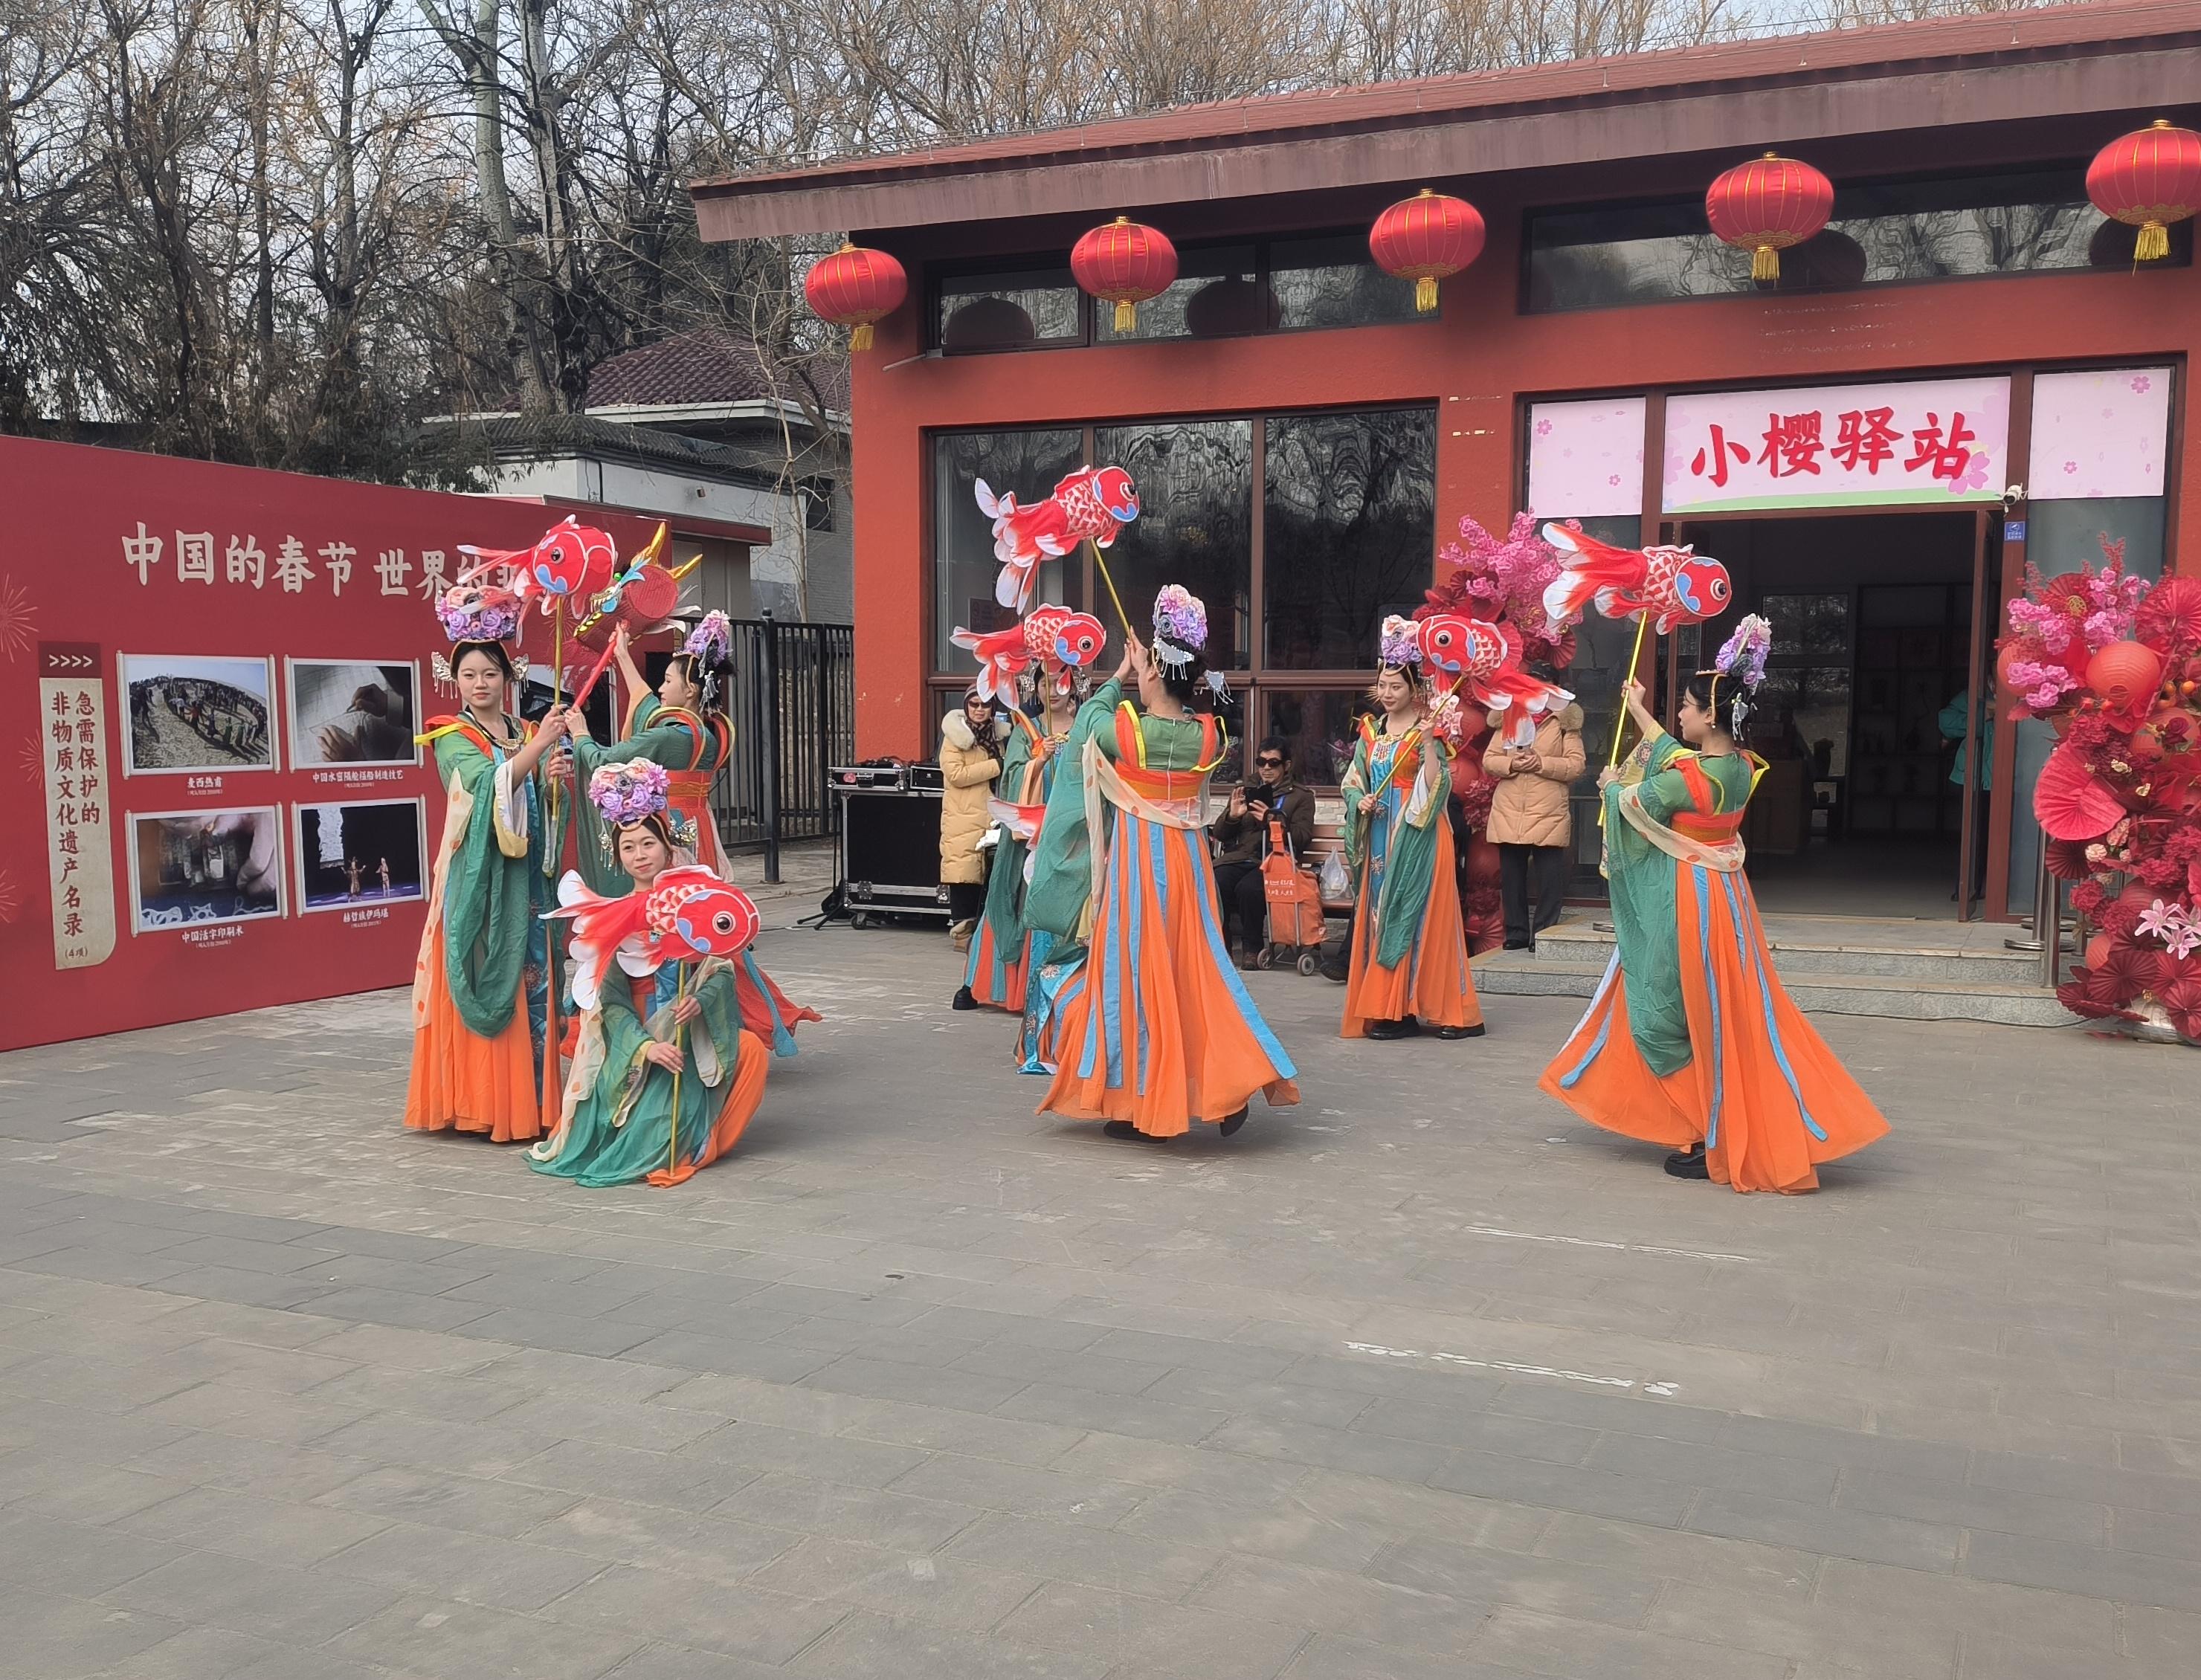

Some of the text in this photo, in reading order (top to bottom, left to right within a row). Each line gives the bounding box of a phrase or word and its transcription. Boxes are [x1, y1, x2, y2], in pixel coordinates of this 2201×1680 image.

[1691, 406, 1976, 487] 小樱驿站
[121, 520, 357, 597] 中国的春节
[75, 691, 100, 824] 急需保护的
[51, 691, 83, 937] 非物质文化遗产名录
